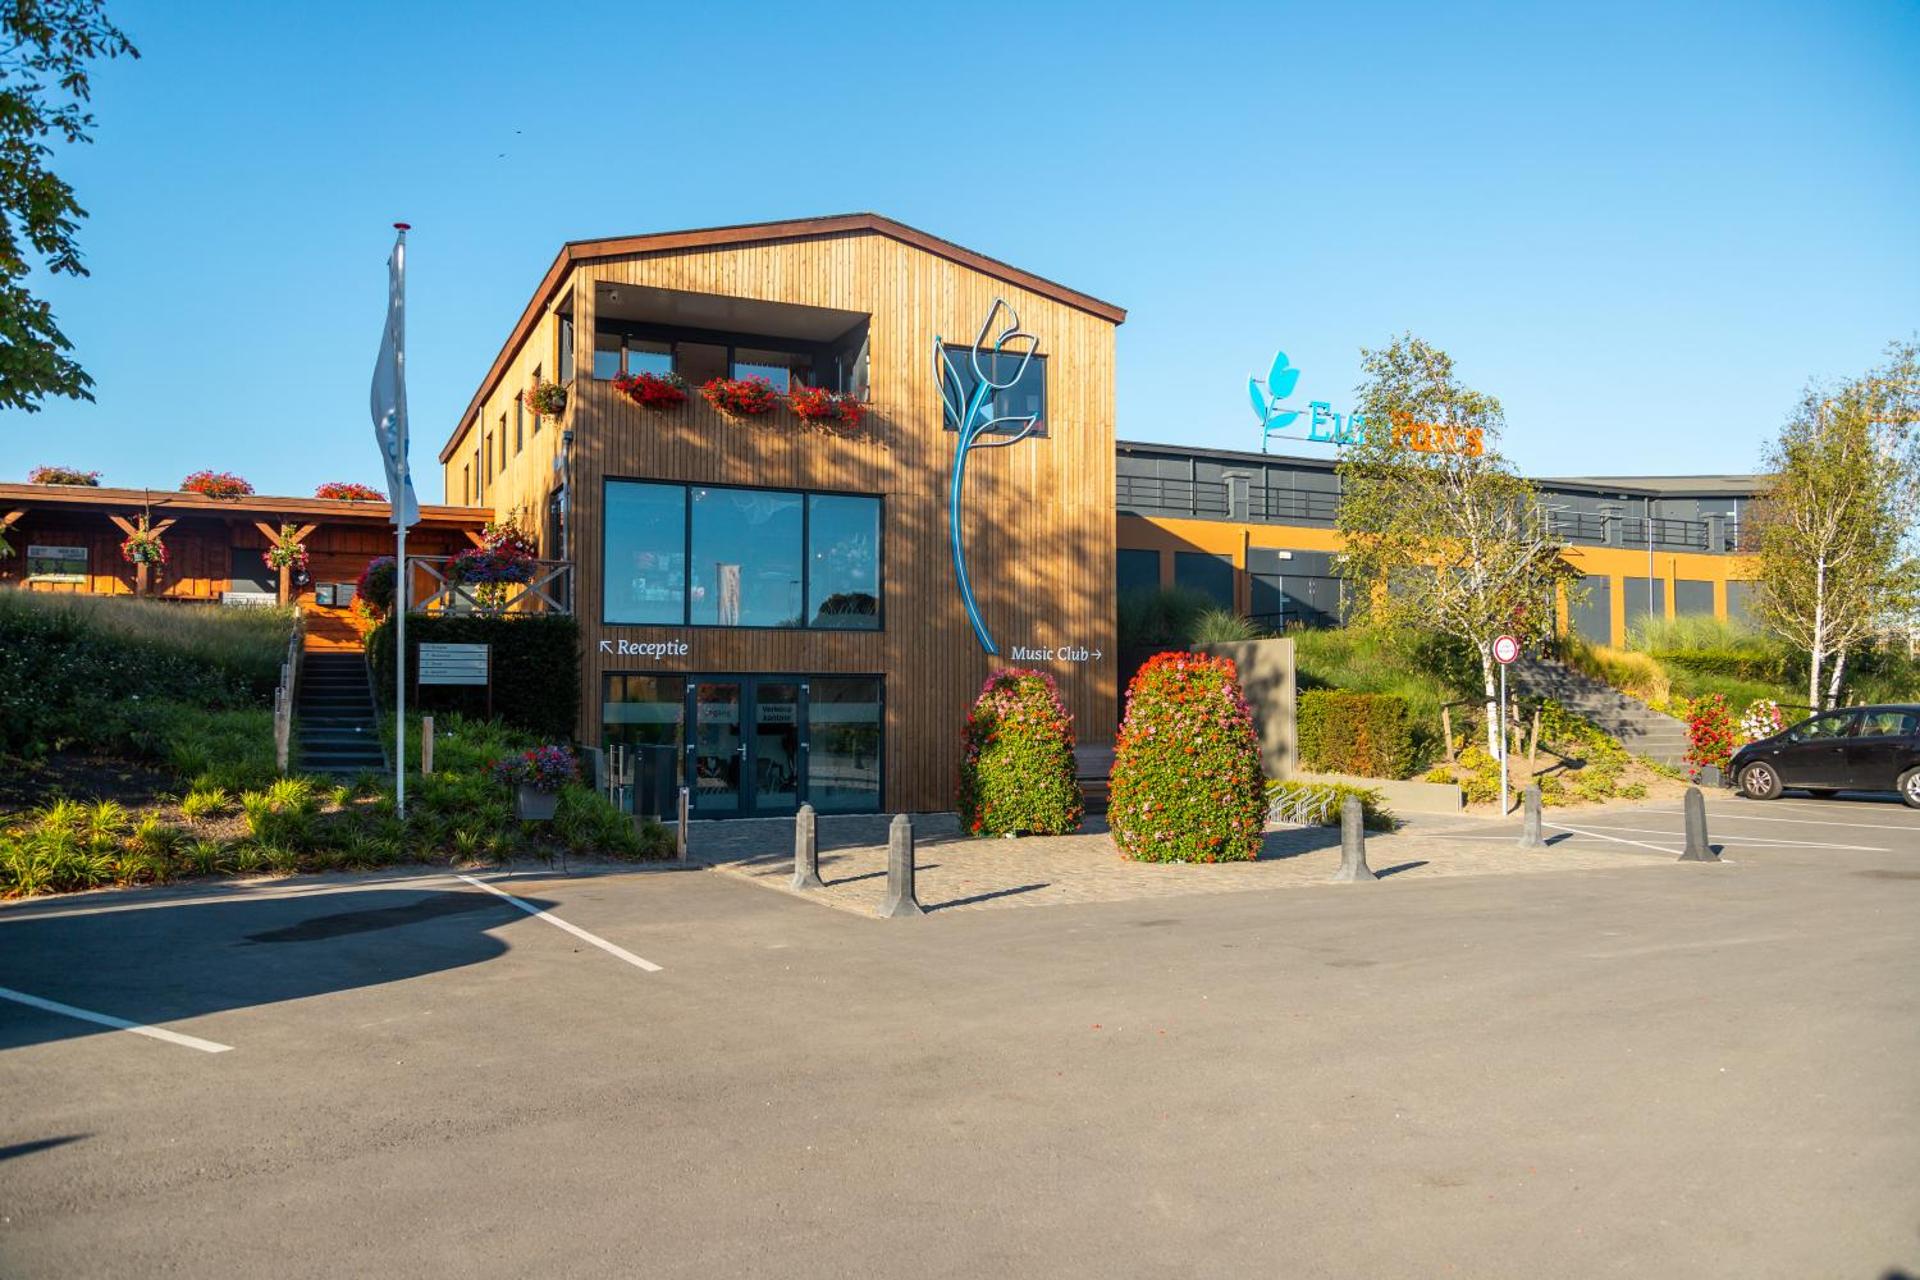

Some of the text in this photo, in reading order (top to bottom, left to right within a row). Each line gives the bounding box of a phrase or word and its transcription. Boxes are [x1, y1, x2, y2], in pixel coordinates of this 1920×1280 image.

[617, 639, 689, 660] Receptie
[1011, 645, 1089, 661] Music Club
